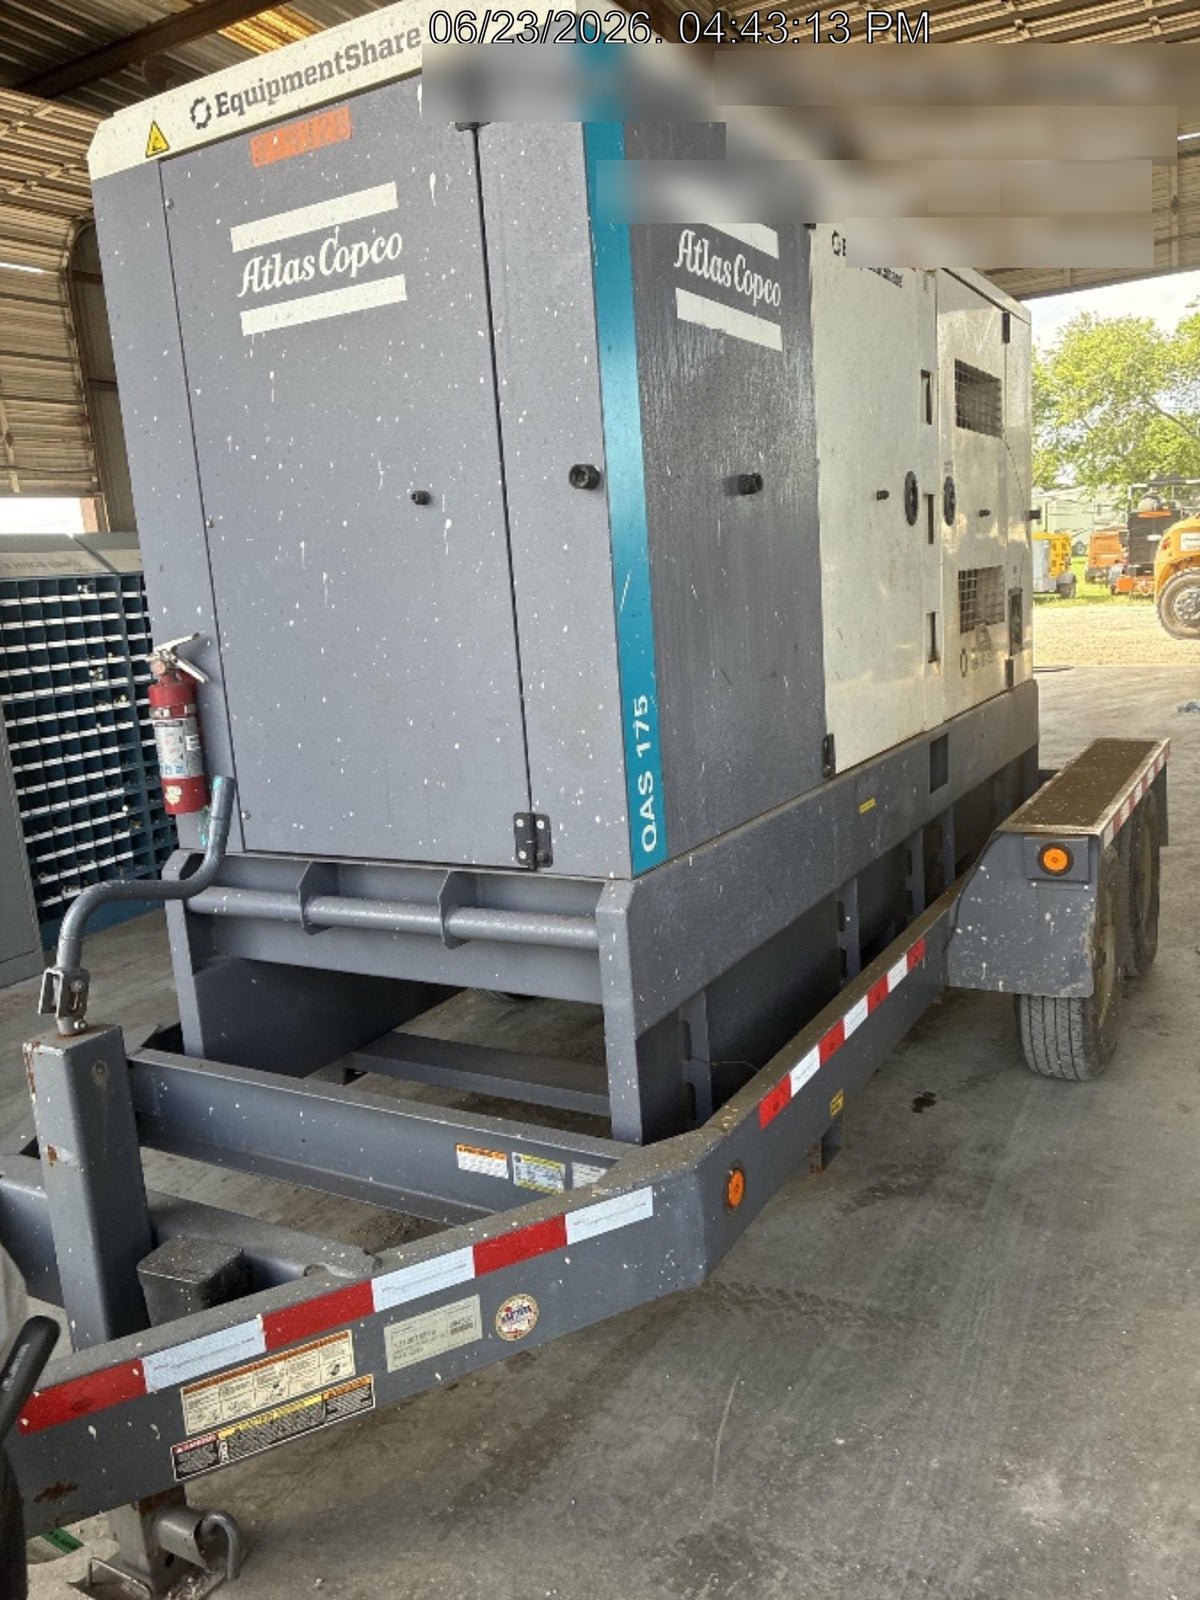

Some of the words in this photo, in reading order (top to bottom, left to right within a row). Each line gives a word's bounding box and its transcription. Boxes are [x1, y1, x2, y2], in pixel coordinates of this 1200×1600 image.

[215, 27, 422, 118] EquipmentShare
[236, 252, 316, 298] Atlas
[319, 232, 403, 278] Copco
[673, 228, 733, 289] Atlas
[733, 253, 782, 307] Copco
[633, 694, 652, 758] 175
[637, 770, 657, 853] QAS
